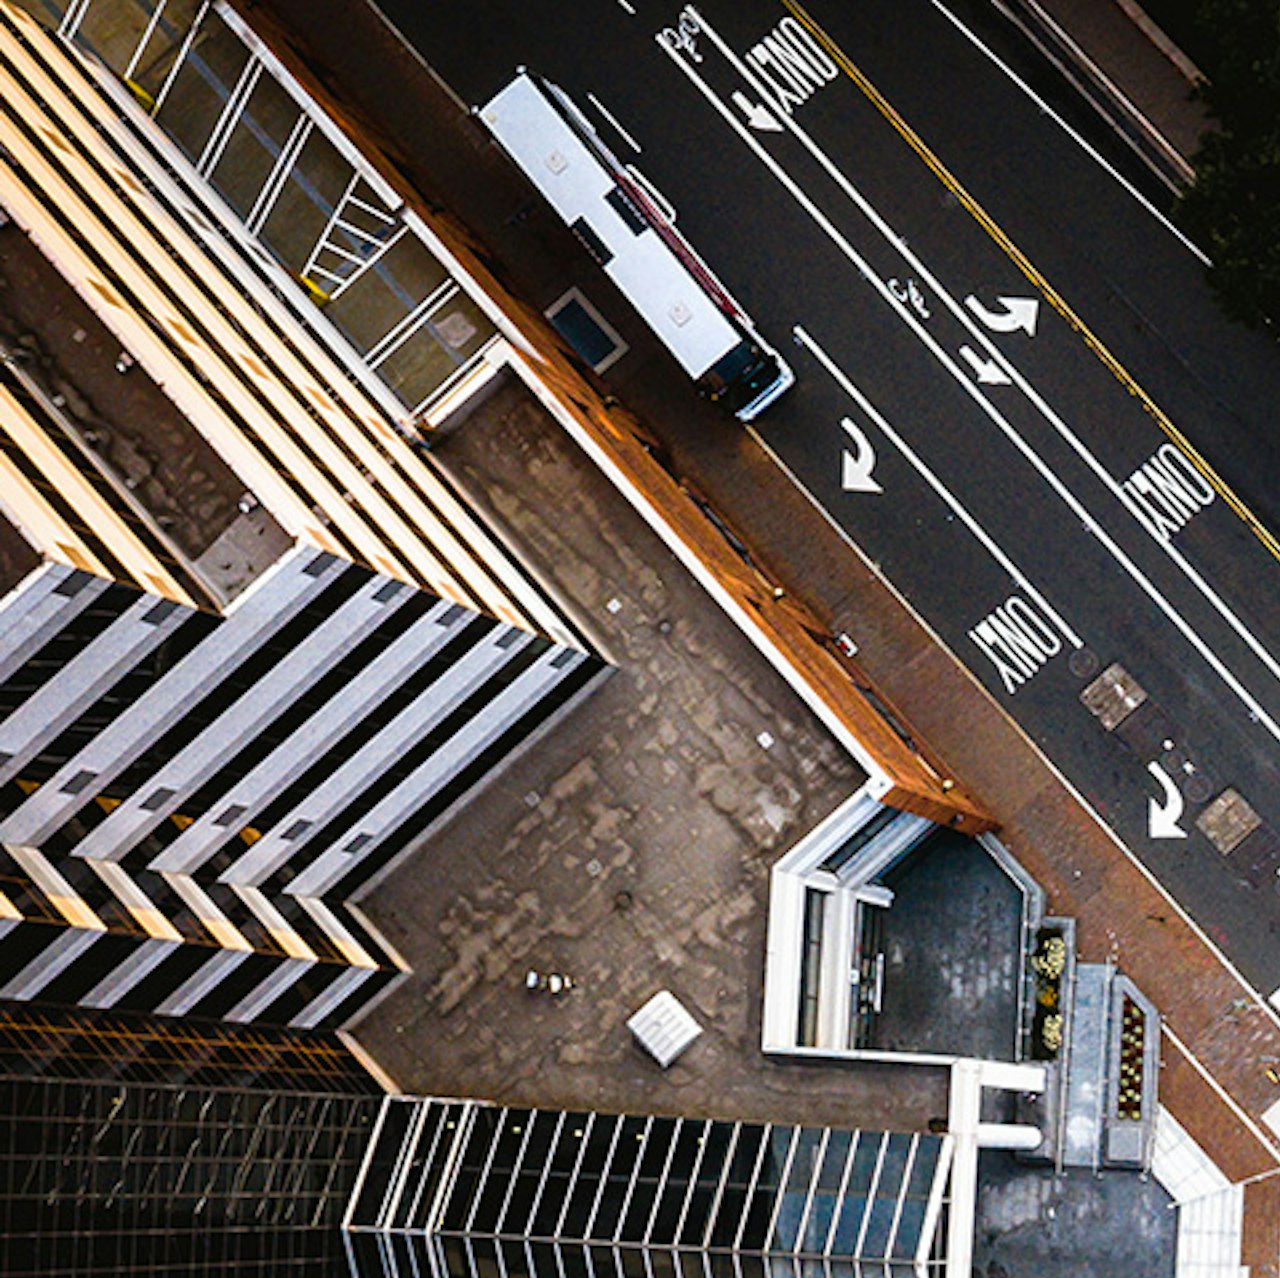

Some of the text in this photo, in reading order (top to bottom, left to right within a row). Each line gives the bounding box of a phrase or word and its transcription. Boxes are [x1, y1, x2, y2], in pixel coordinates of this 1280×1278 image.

[746, 17, 839, 114] ONLY
[1122, 443, 1215, 541] ONLY
[968, 596, 1061, 694] ONLY
